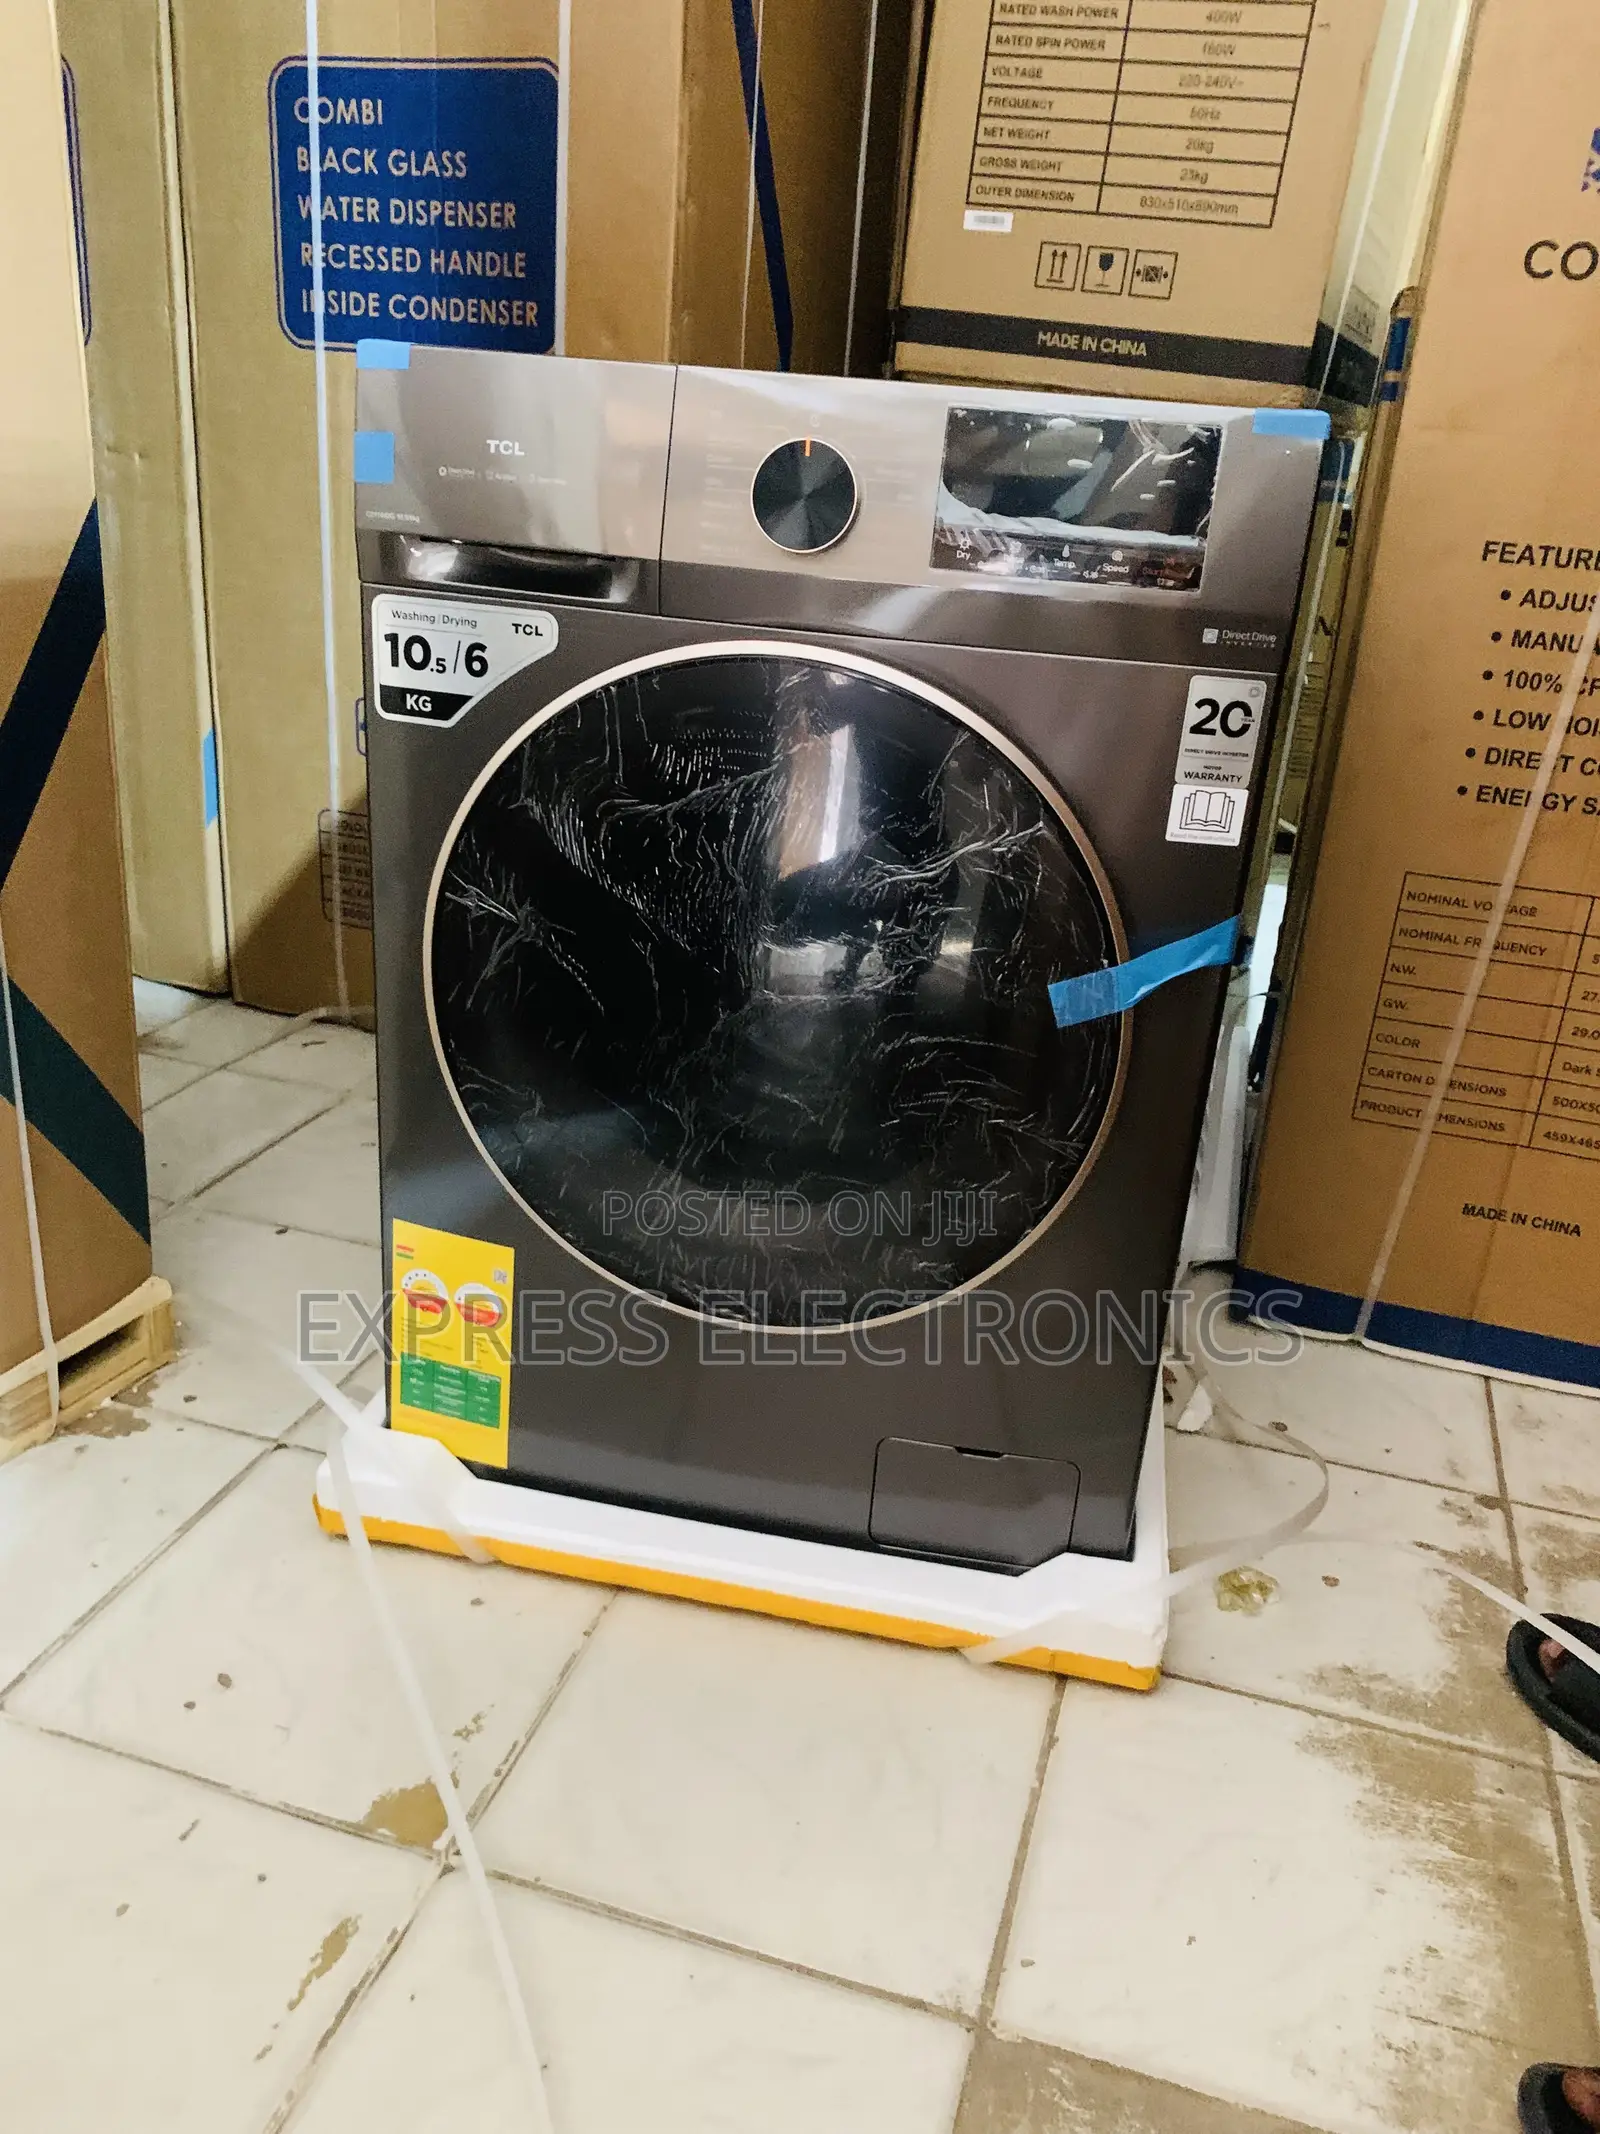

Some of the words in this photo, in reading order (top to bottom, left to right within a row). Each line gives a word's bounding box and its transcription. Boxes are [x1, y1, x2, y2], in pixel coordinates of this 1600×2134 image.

[1076, 6, 1119, 20] POWER
[996, 34, 1033, 47] RATED
[1064, 38, 1106, 51] POWER
[991, 66, 1043, 79] VOLTAGE
[294, 96, 384, 125] COMBI
[987, 96, 1054, 111] FREQUENCY
[983, 126, 1004, 138] NET
[1007, 127, 1051, 140] WEIGHT
[296, 145, 379, 175] BACK
[387, 148, 467, 178] GLASS
[979, 156, 1017, 169] GROSS
[1020, 158, 1063, 173] WEIGHT
[976, 184, 1012, 198] OUTER
[1014, 187, 1075, 202] DIMENSION
[389, 197, 516, 229] DISPENSER
[430, 248, 526, 279] HANDLE
[388, 293, 538, 327] CONDENSER
[1037, 330, 1079, 350] MADE
[1082, 335, 1098, 352] IN
[1100, 337, 1147, 357] CHINA
[486, 439, 525, 456] TCL
[957, 550, 971, 560] Dry
[391, 609, 436, 625] Washing
[442, 614, 478, 630] Drying
[512, 622, 544, 637] TCL
[1504, 669, 1563, 694] 100%
[405, 693, 432, 713] KG
[1189, 697, 1253, 739] 20
[1493, 708, 1552, 731] LOW
[1484, 746, 1575, 773] DIRET
[1579, 757, 1600, 777] C
[1184, 770, 1243, 783] WARRANTY
[1406, 890, 1469, 909] NOMINAL
[1473, 900, 1538, 918] VOAGE
[1399, 927, 1461, 945] NOMINAL
[1375, 1032, 1421, 1049] COLOR
[1562, 1061, 1592, 1076] Dark
[1367, 1066, 1424, 1086] CARTON
[1425, 1075, 1508, 1097] DENSIONS
[1360, 1100, 1422, 1119] PRODUCT
[1437, 1112, 1506, 1132] MENSIONS
[1462, 1203, 1508, 1222] MADE
[1510, 1211, 1529, 1226] IN
[1531, 1216, 1582, 1238] CHINA
